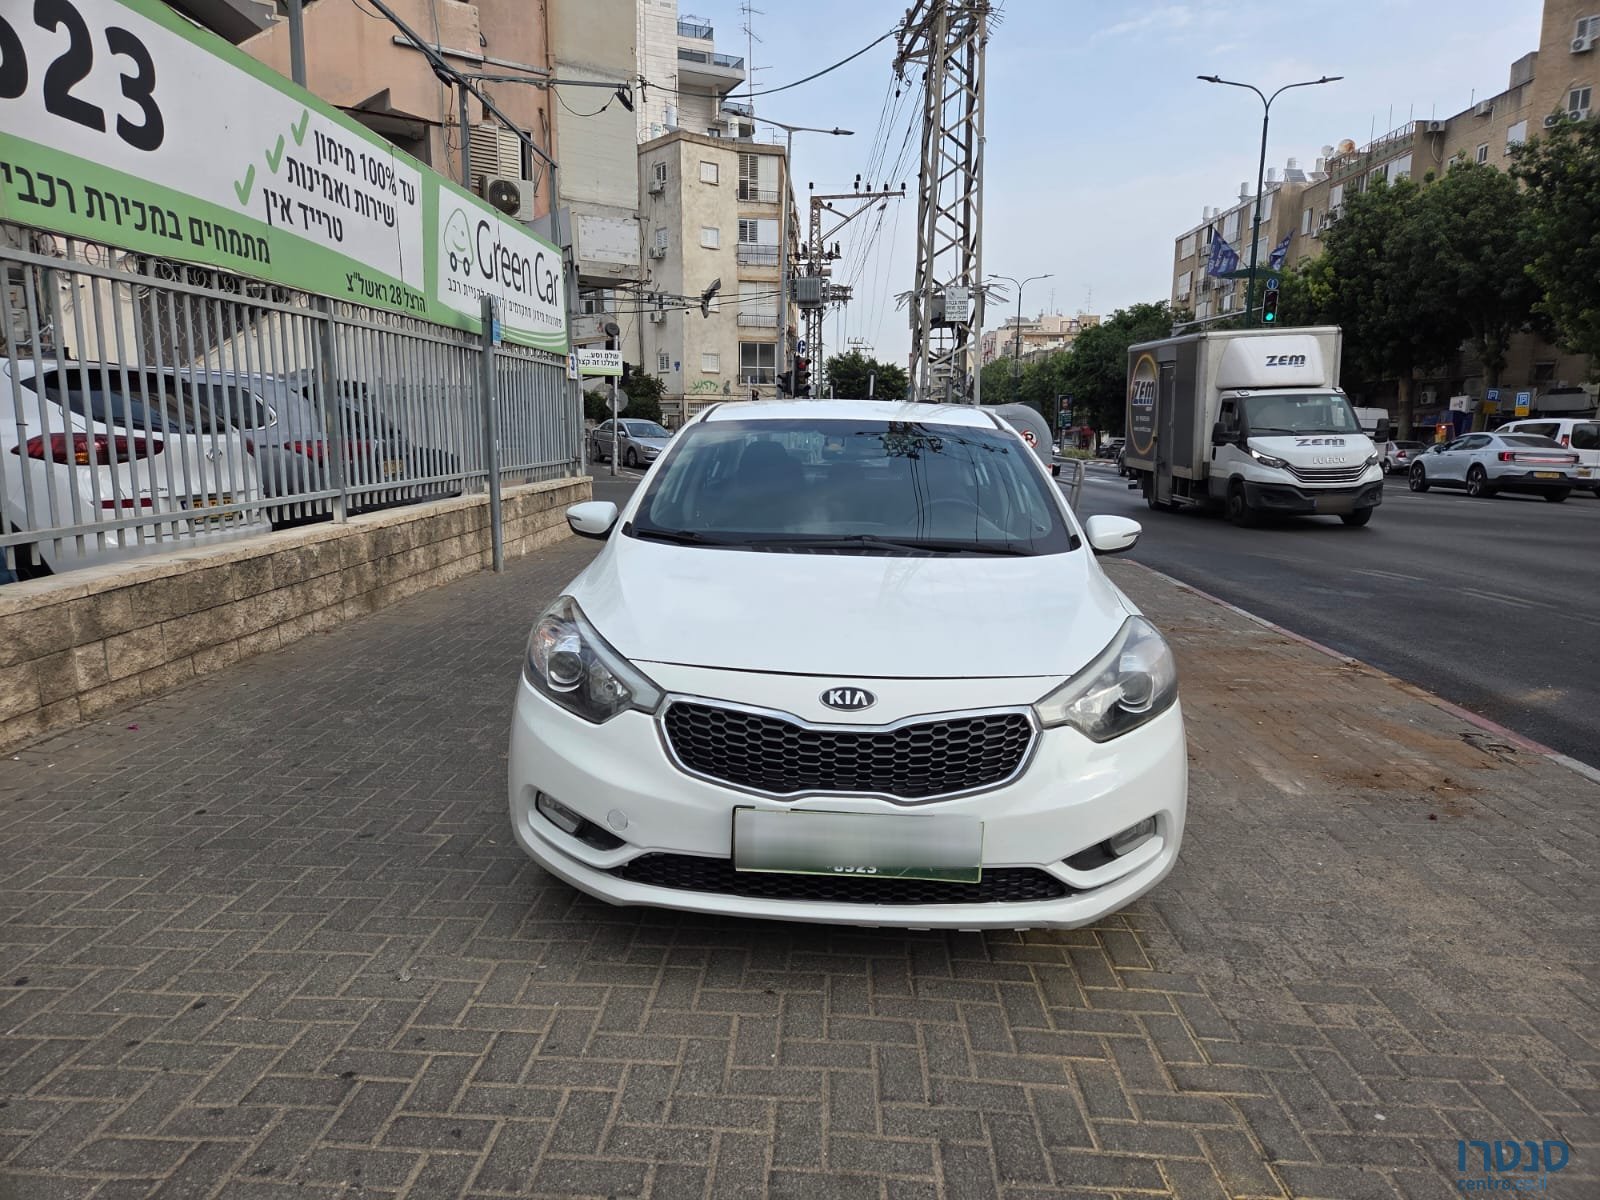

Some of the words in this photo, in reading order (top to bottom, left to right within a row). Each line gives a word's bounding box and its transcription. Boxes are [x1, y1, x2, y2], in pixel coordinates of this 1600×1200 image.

[314, 129, 356, 175] מימון
[286, 156, 351, 209] ואמינות
[359, 153, 397, 196] 100%
[399, 178, 415, 206] עד
[84, 185, 183, 241] במכירת
[263, 187, 294, 226] אין
[297, 201, 344, 243] טרייד
[354, 188, 395, 228] שירות
[188, 215, 271, 265] מתמחים
[476, 219, 532, 297] Green
[535, 251, 559, 307] Car
[389, 283, 402, 306] 28
[403, 286, 426, 313] הרצל
[447, 277, 462, 295] רכב
[828, 690, 868, 706] KIA
